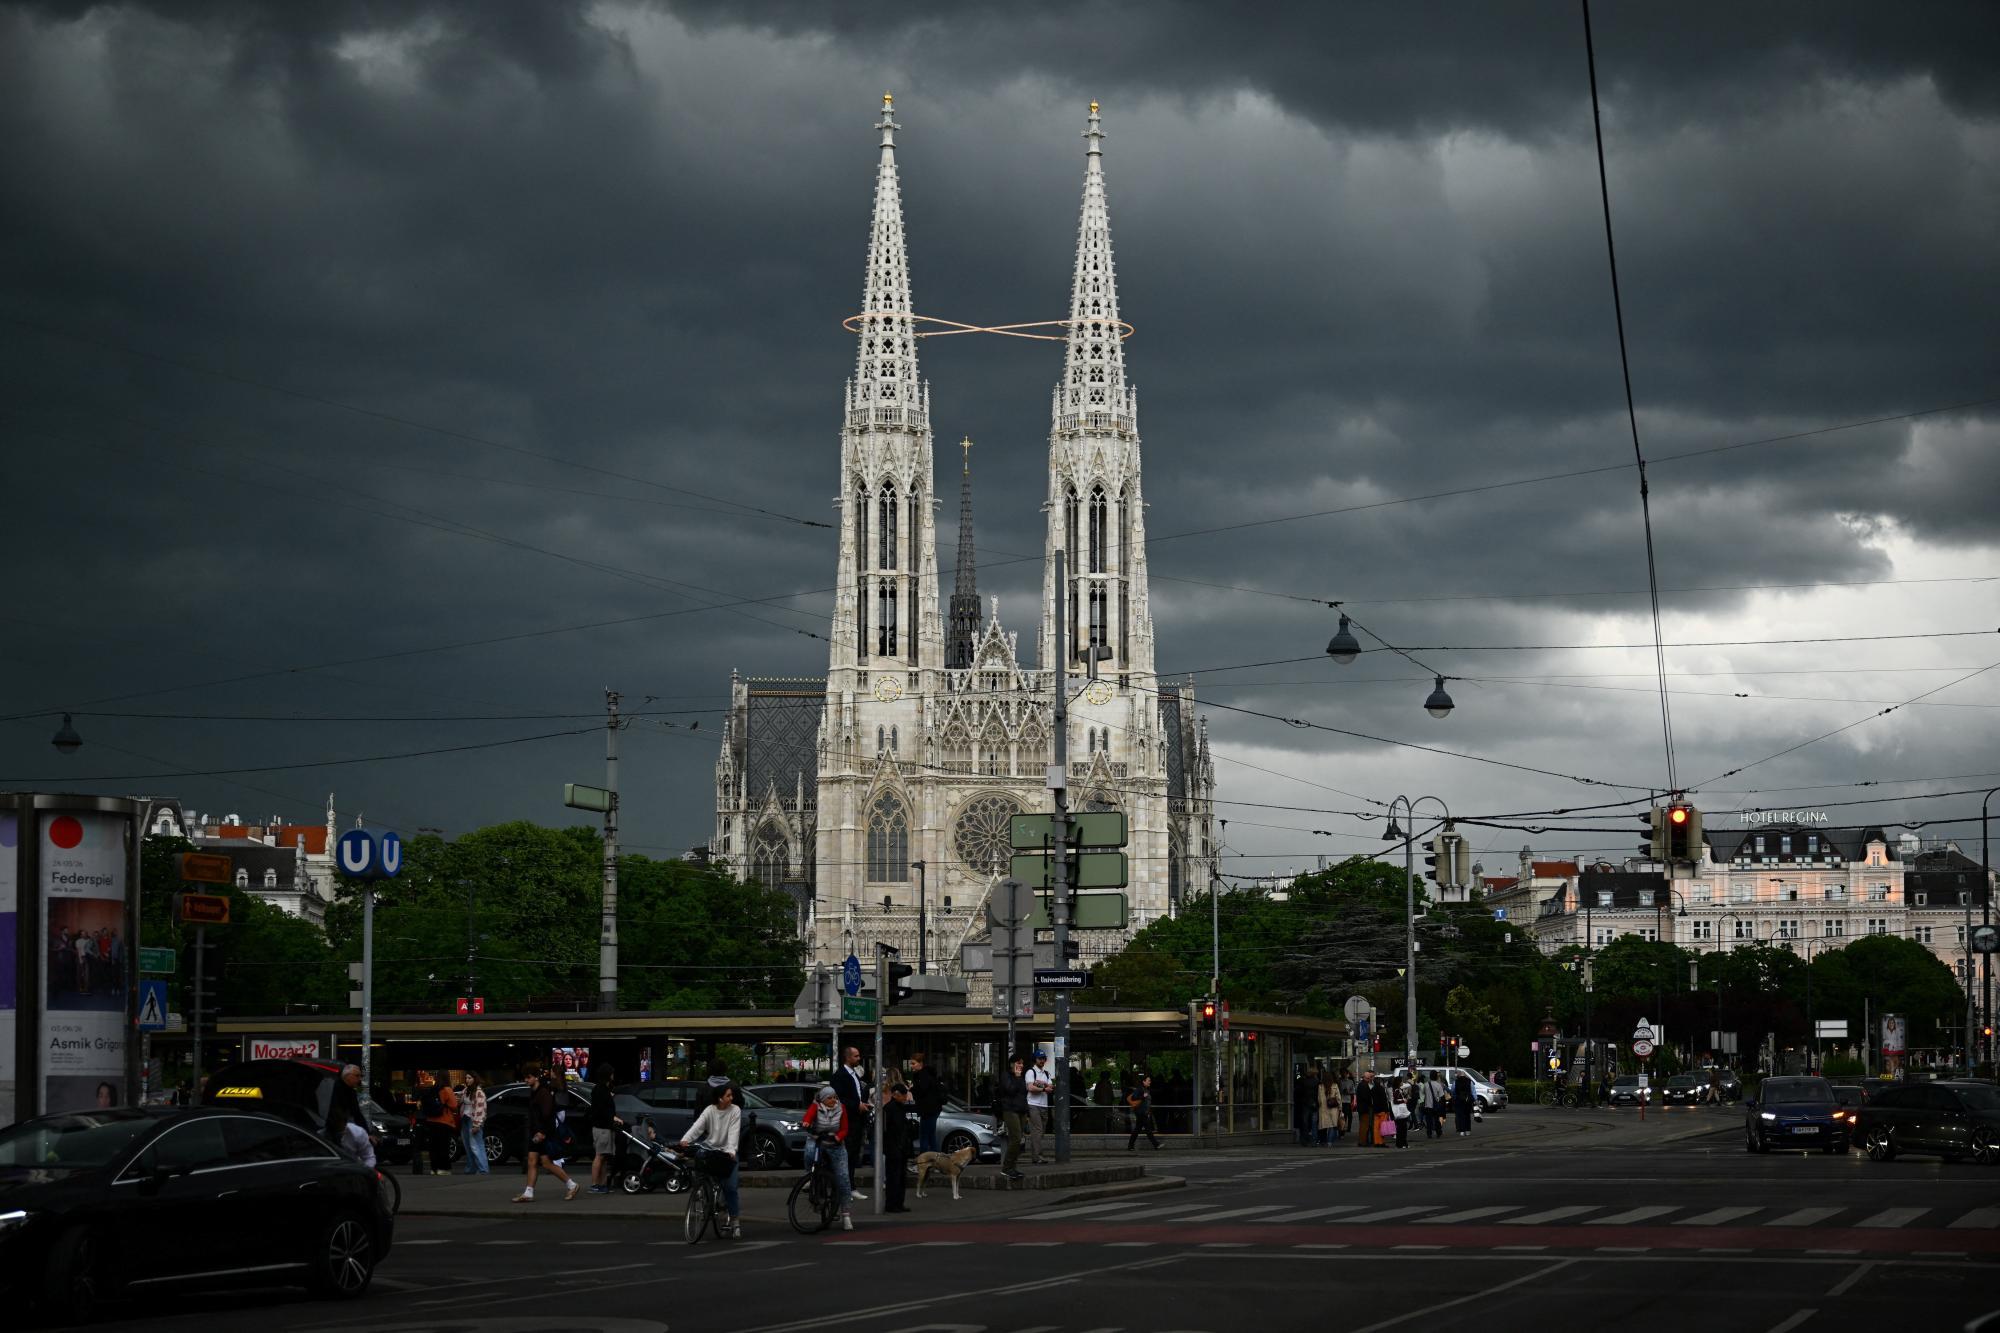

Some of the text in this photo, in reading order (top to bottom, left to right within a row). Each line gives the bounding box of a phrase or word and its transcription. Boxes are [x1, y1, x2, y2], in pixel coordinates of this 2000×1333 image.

[1740, 811, 1828, 823] HOTEL REGINA
[343, 839, 370, 873] U
[383, 838, 400, 873] U
[52, 871, 114, 887] Federspiel
[460, 1002, 481, 1010] AS
[50, 1037, 92, 1049] Asmik
[255, 1042, 317, 1059] Mozart?
[223, 1087, 254, 1095] TAXI
